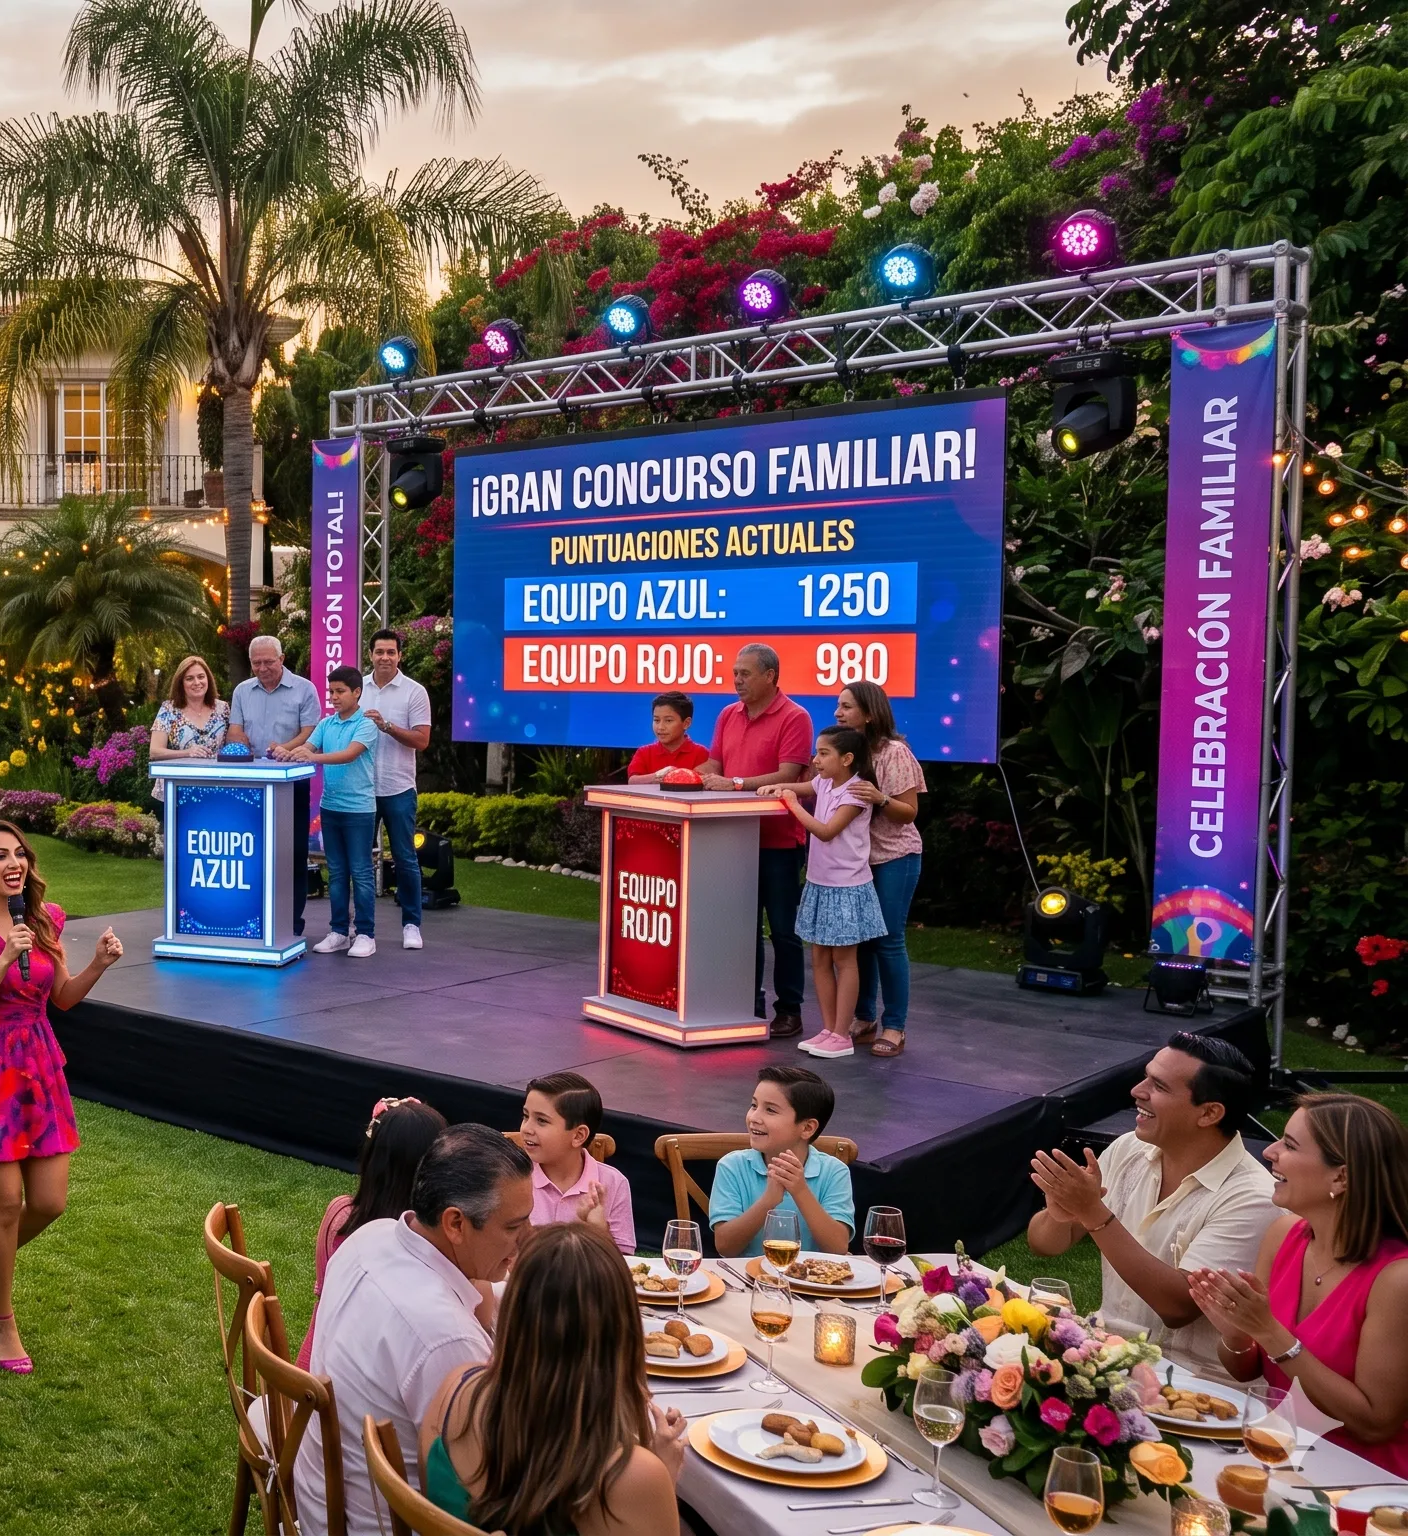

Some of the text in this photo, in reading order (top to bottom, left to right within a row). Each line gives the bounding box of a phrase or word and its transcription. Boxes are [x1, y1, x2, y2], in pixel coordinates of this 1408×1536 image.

[472, 428, 976, 518] ¡GRAN CONCURSO FAMILIAR!
[326, 490, 344, 588] TOTAL!
[550, 518, 855, 566] PUNTUACIONES ACTUALES
[523, 571, 890, 625] EQUIPO AZUL: 1250
[1188, 396, 1238, 858] CELEBRACIÓN FAMILIAR
[522, 642, 888, 686] EQUIPO ROJO: 980
[187, 829, 254, 857] EQUIPO
[190, 858, 251, 890] AZUL
[619, 871, 677, 908] EQUIPO
[622, 905, 673, 947] ROJO
